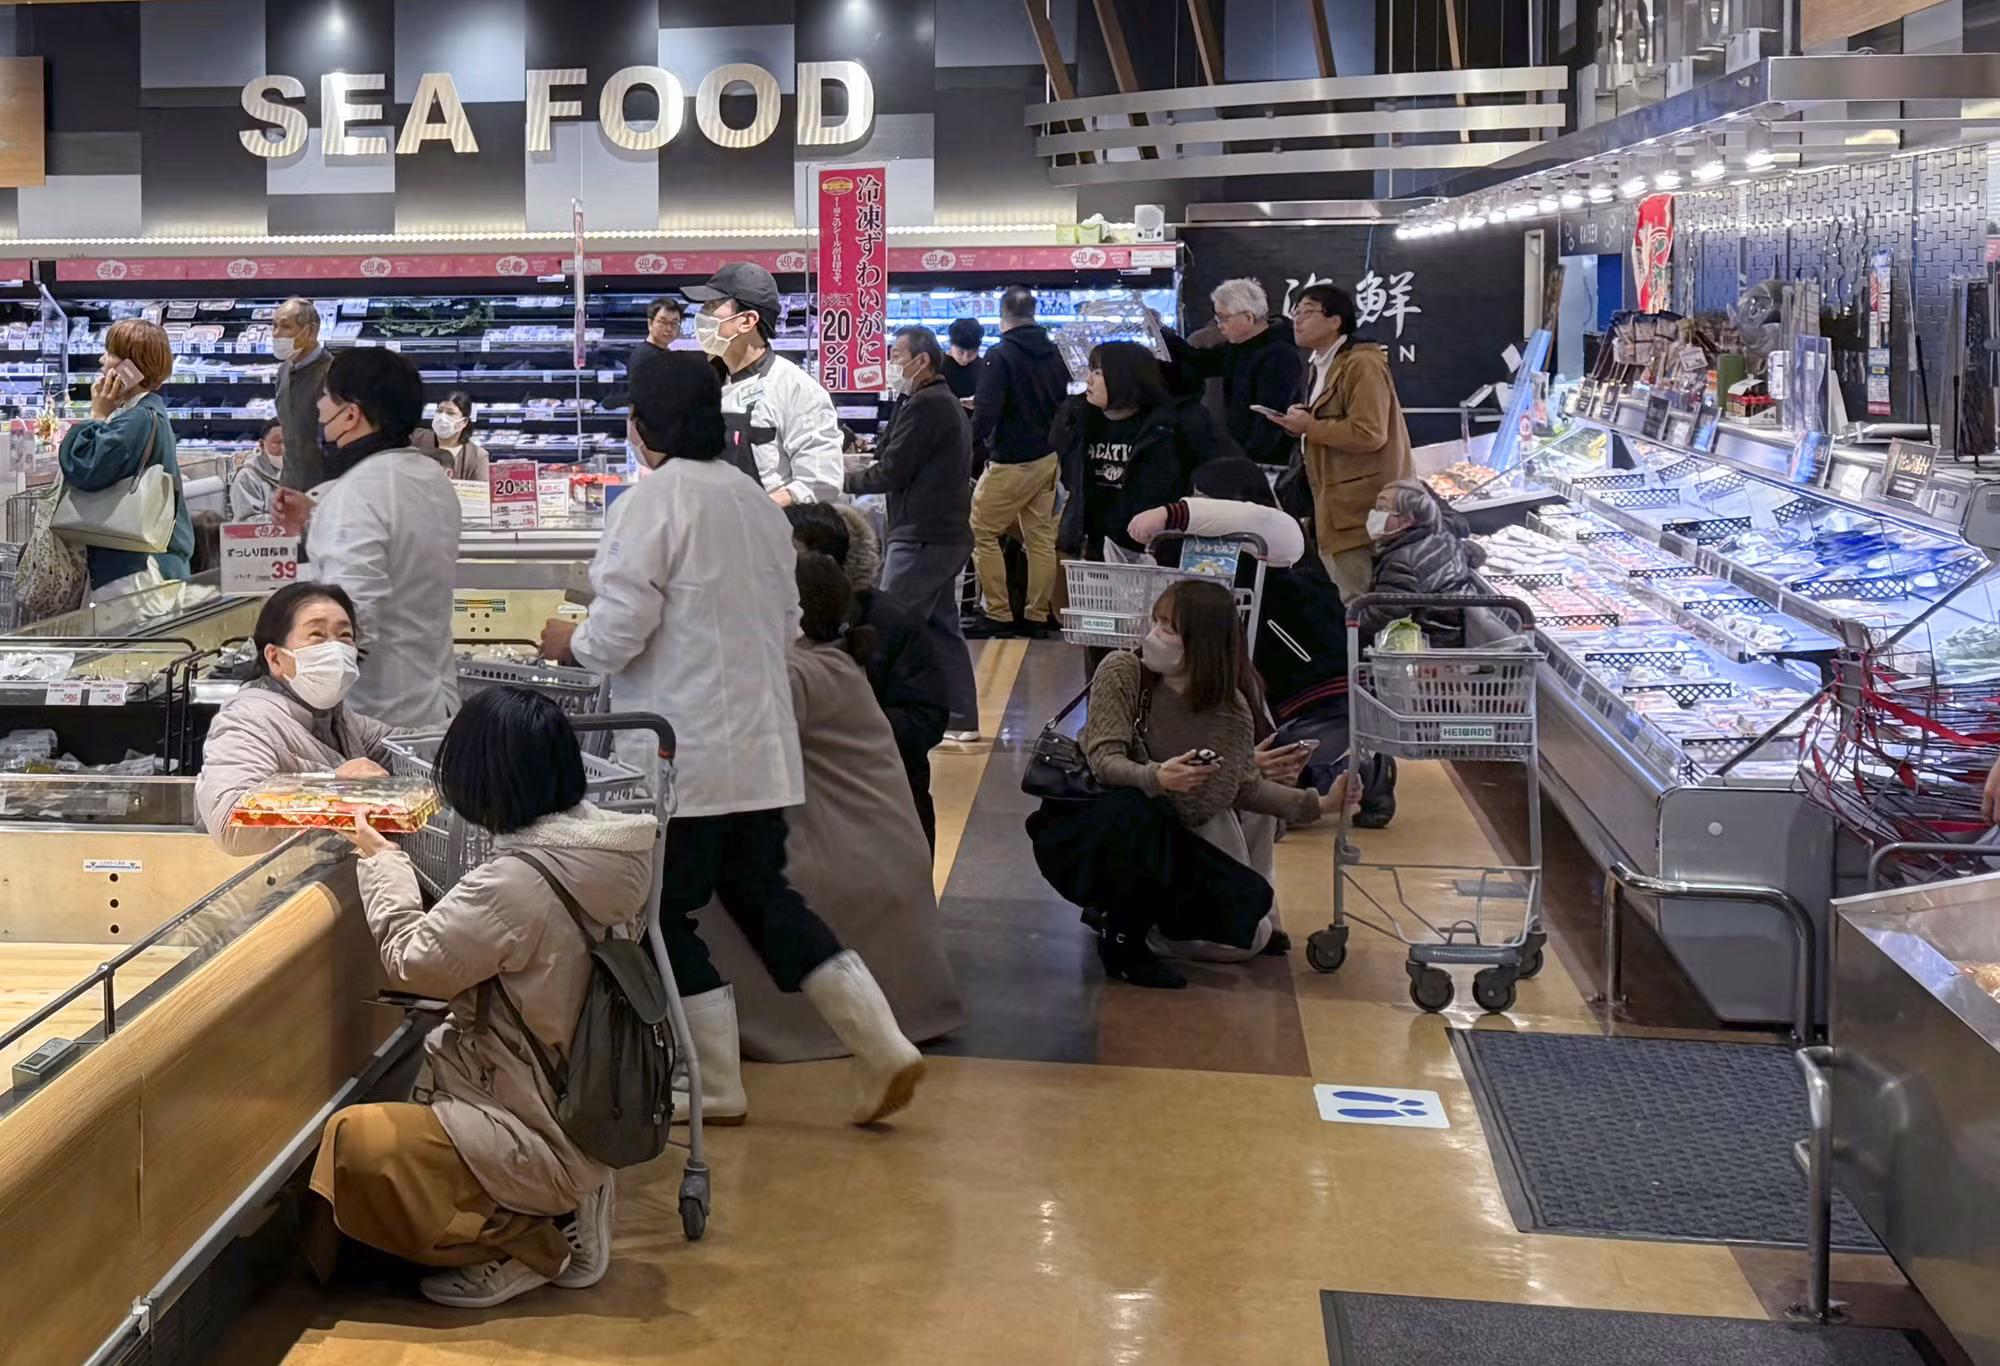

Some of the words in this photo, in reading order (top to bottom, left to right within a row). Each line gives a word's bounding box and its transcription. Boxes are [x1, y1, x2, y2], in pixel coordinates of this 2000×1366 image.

[239, 72, 479, 157] SEA
[525, 61, 874, 152] FOOD
[855, 174, 882, 365] 冷凍ずわいがに
[821, 308, 851, 390] 20%引
[1088, 442, 1132, 462] ACATI
[1443, 727, 1493, 737] HEIWADO
